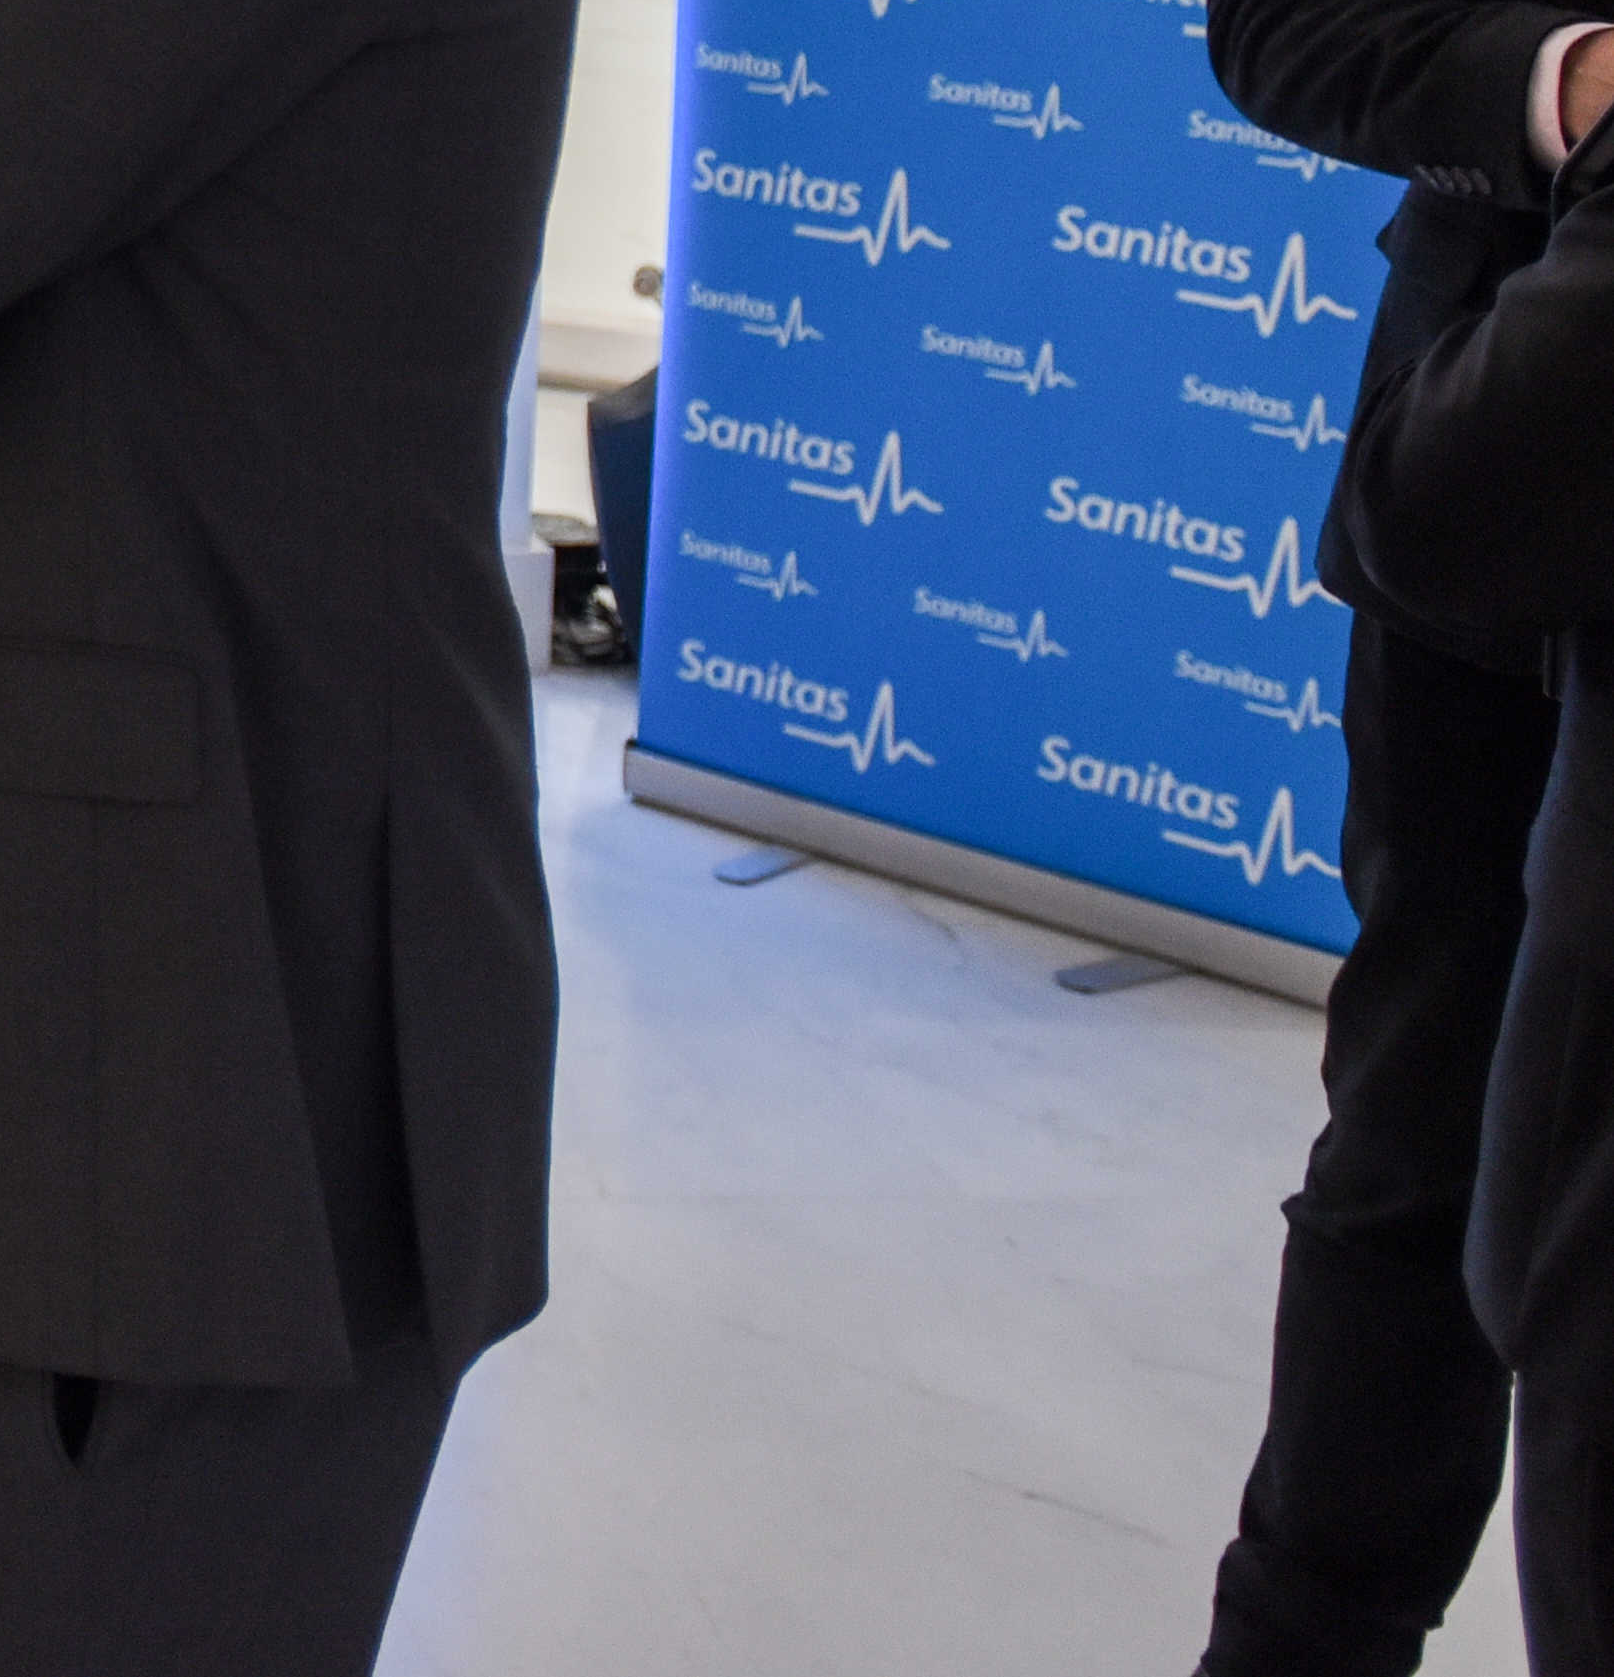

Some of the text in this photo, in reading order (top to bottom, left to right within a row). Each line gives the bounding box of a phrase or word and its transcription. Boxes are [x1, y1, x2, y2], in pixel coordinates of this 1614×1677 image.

[698, 47, 782, 79] Sanitas
[928, 74, 1032, 112] Sanitas
[693, 151, 862, 216] Sanitas
[1052, 204, 1252, 282] Sanitas
[689, 284, 776, 322] Sanitas
[922, 324, 1025, 368] Sanitas
[1182, 375, 1294, 422] Sanitas
[684, 400, 855, 475] Sanitas
[1044, 476, 1245, 562] Sanitas
[680, 531, 772, 575] Sanitas
[914, 587, 1018, 634] Sanitas
[677, 639, 848, 721] Sanitas
[1174, 650, 1287, 702] Sanitas
[1036, 735, 1239, 829] Sanitas
